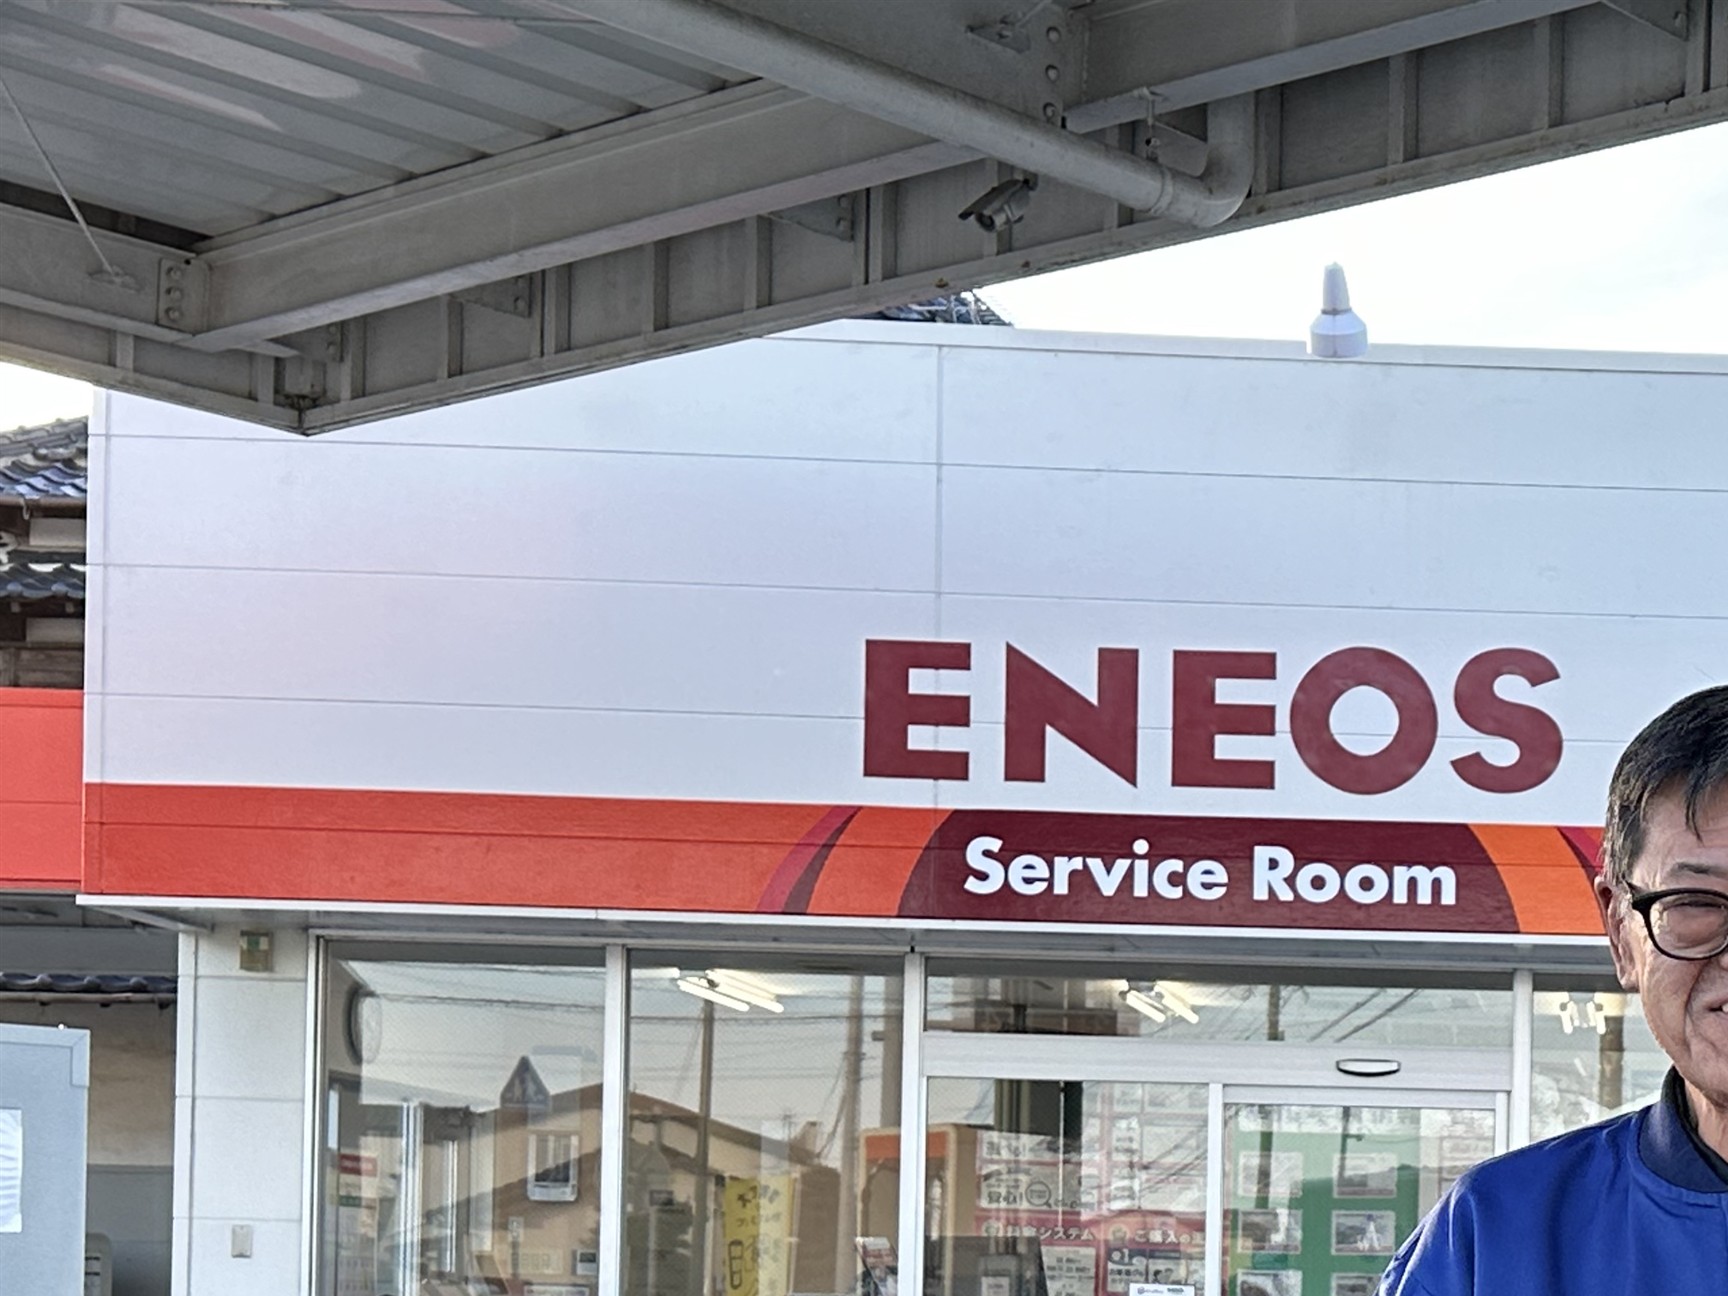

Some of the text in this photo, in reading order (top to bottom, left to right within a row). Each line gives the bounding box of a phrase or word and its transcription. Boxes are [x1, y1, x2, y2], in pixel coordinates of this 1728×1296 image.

[863, 639, 1564, 795] ENEOS
[963, 835, 1456, 905] Service Room
